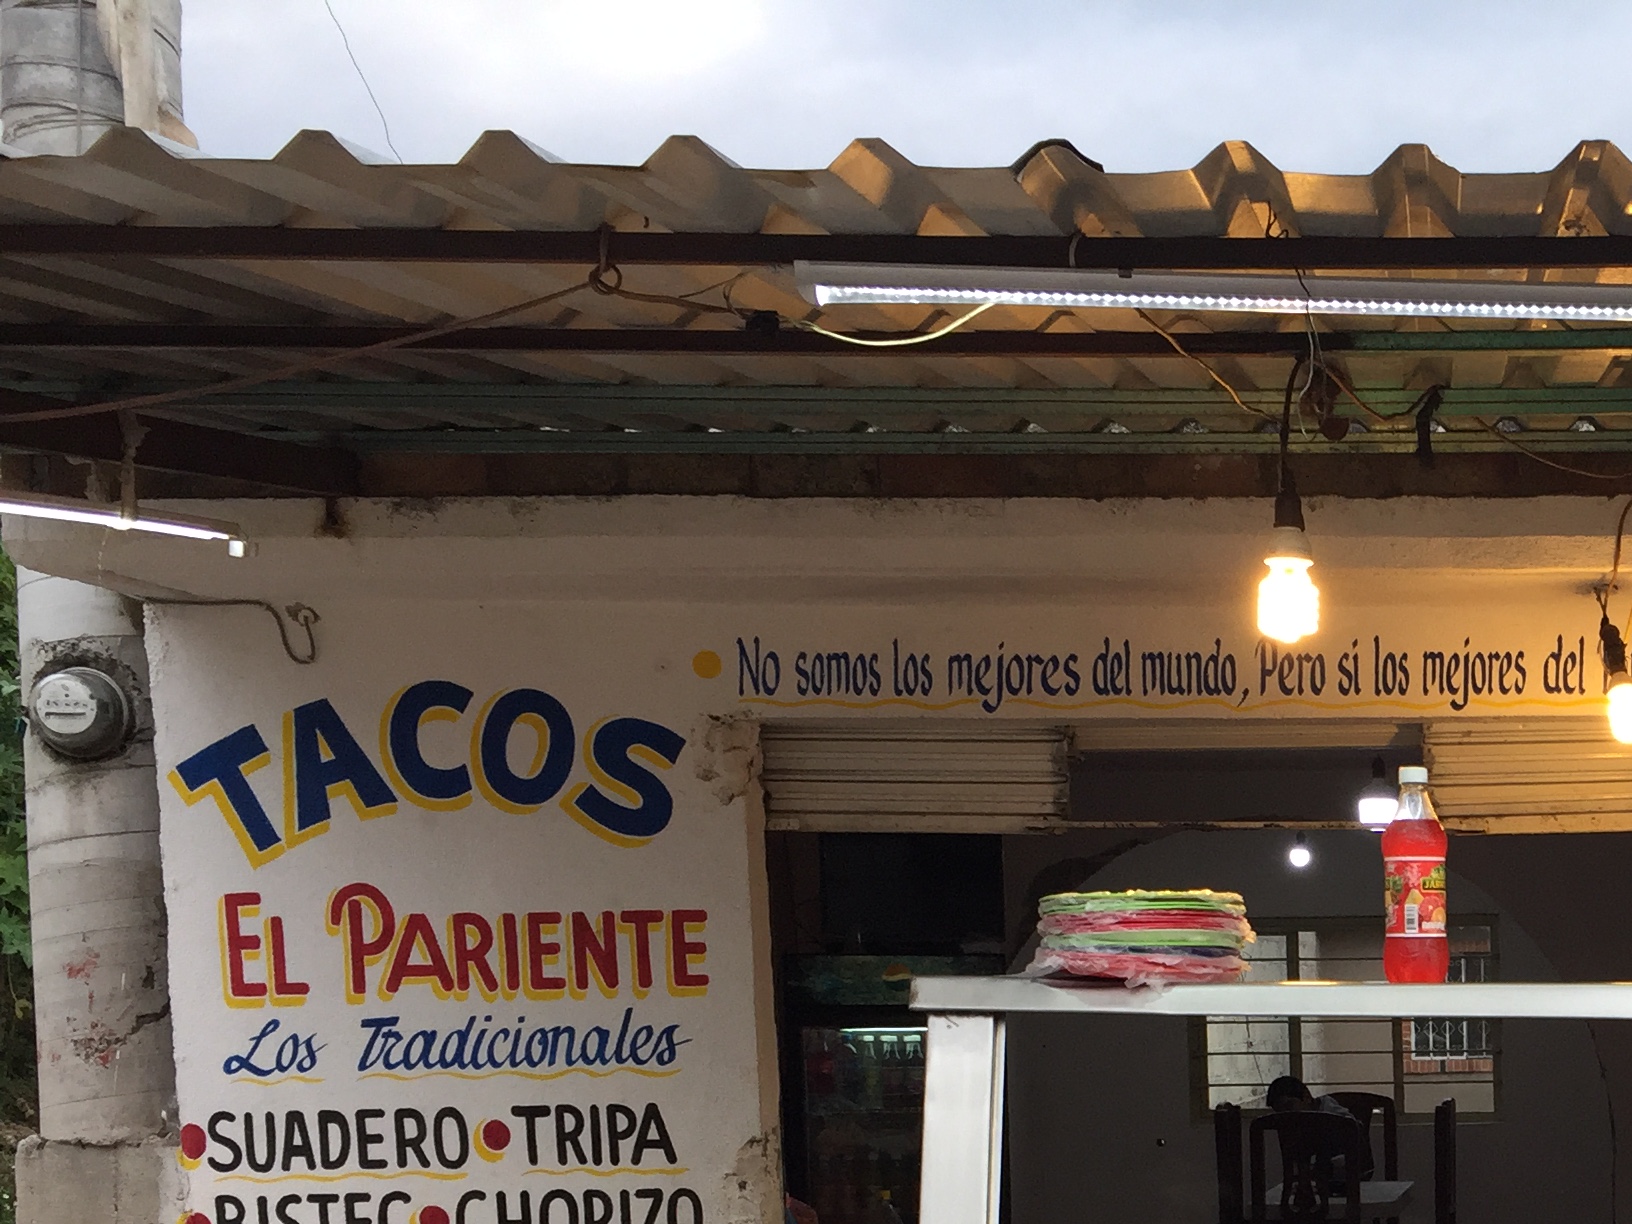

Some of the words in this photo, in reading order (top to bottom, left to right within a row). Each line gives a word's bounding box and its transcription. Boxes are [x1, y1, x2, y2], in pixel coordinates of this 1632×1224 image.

[736, 636, 781, 698] No
[795, 649, 882, 697] somos
[892, 638, 934, 698] los
[948, 640, 1081, 714] mejores
[1092, 636, 1132, 698] del
[1255, 638, 1326, 697] Pero
[1337, 638, 1363, 697] si
[1373, 635, 1411, 698] los
[1421, 637, 1527, 711] mejores
[1542, 633, 1587, 697] del
[168, 680, 688, 866] TACOS
[220, 891, 311, 1006] EL
[328, 882, 711, 1001] PARIENTE
[222, 1018, 328, 1077] Los
[357, 1007, 693, 1073] Tradicionales
[206, 1105, 470, 1173] SUADERO
[510, 1102, 678, 1167] TRIPA
